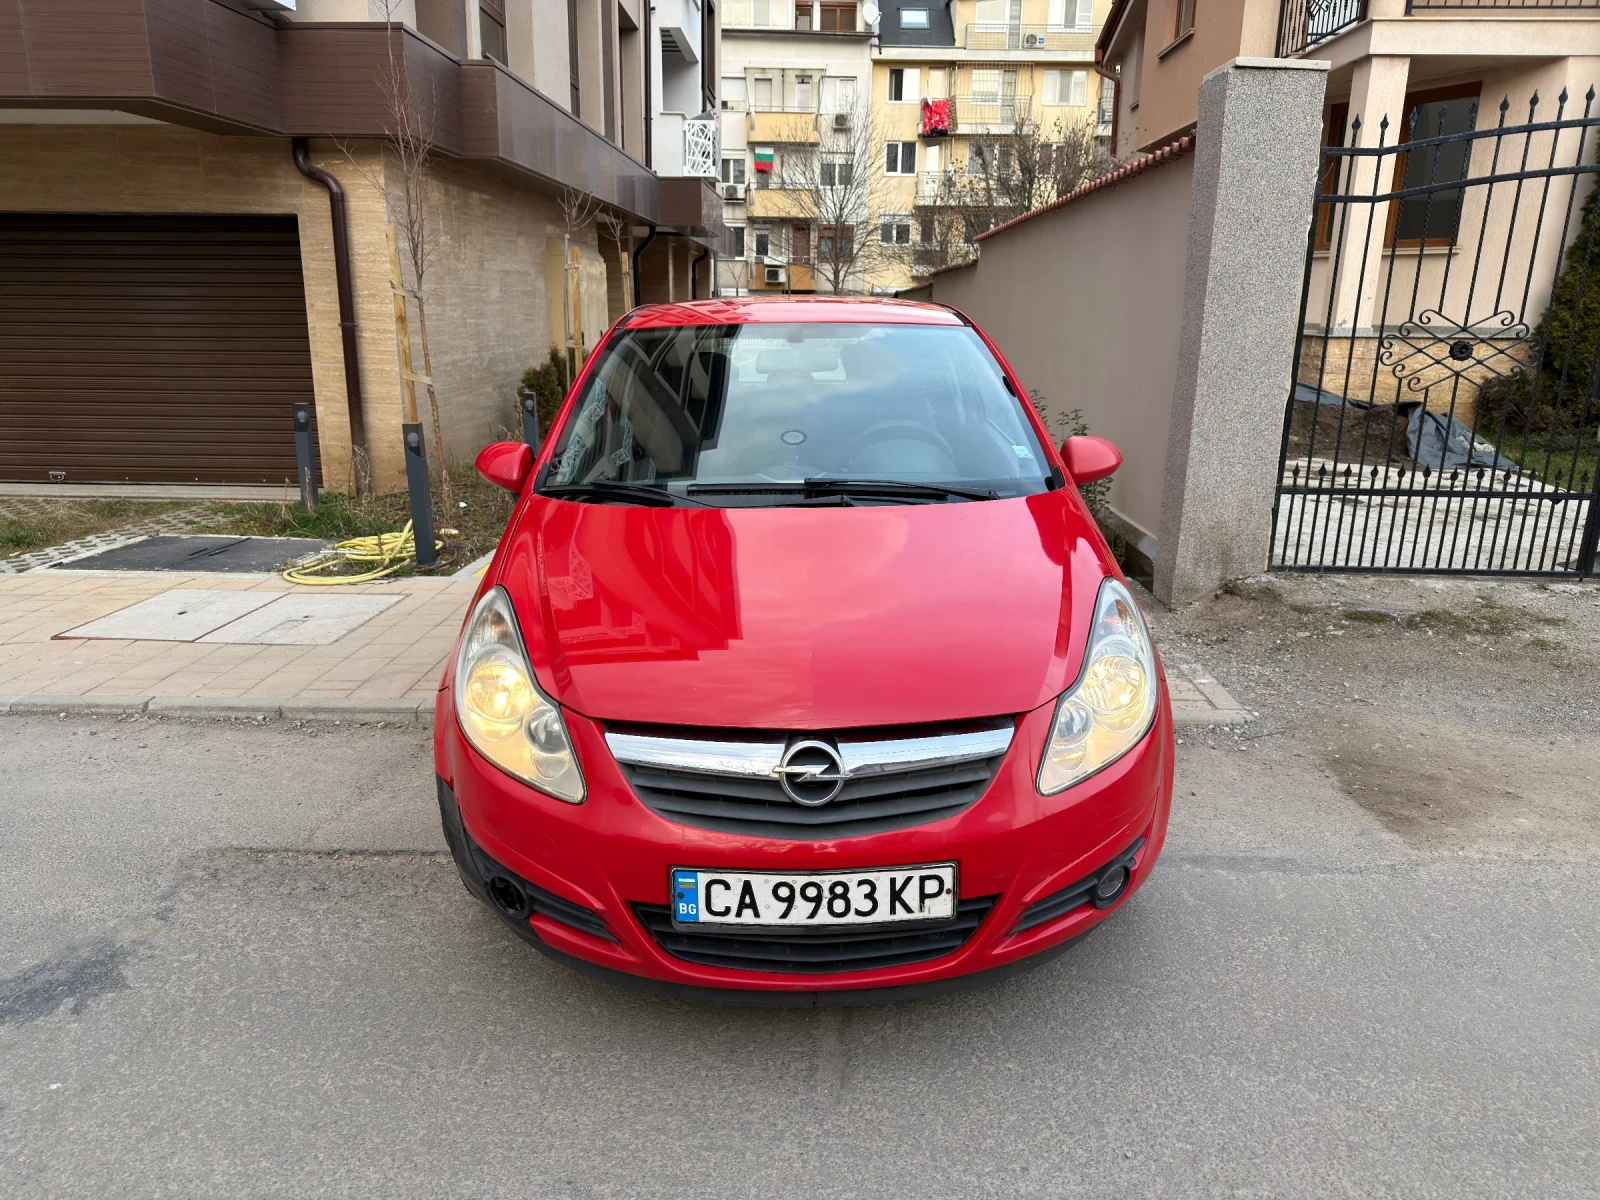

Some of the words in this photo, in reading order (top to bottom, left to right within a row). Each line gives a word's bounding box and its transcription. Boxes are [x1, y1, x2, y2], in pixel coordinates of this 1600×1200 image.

[679, 903, 697, 915] BG
[705, 878, 760, 918] CA
[772, 879, 878, 919] 9983
[889, 874, 945, 915] KP
